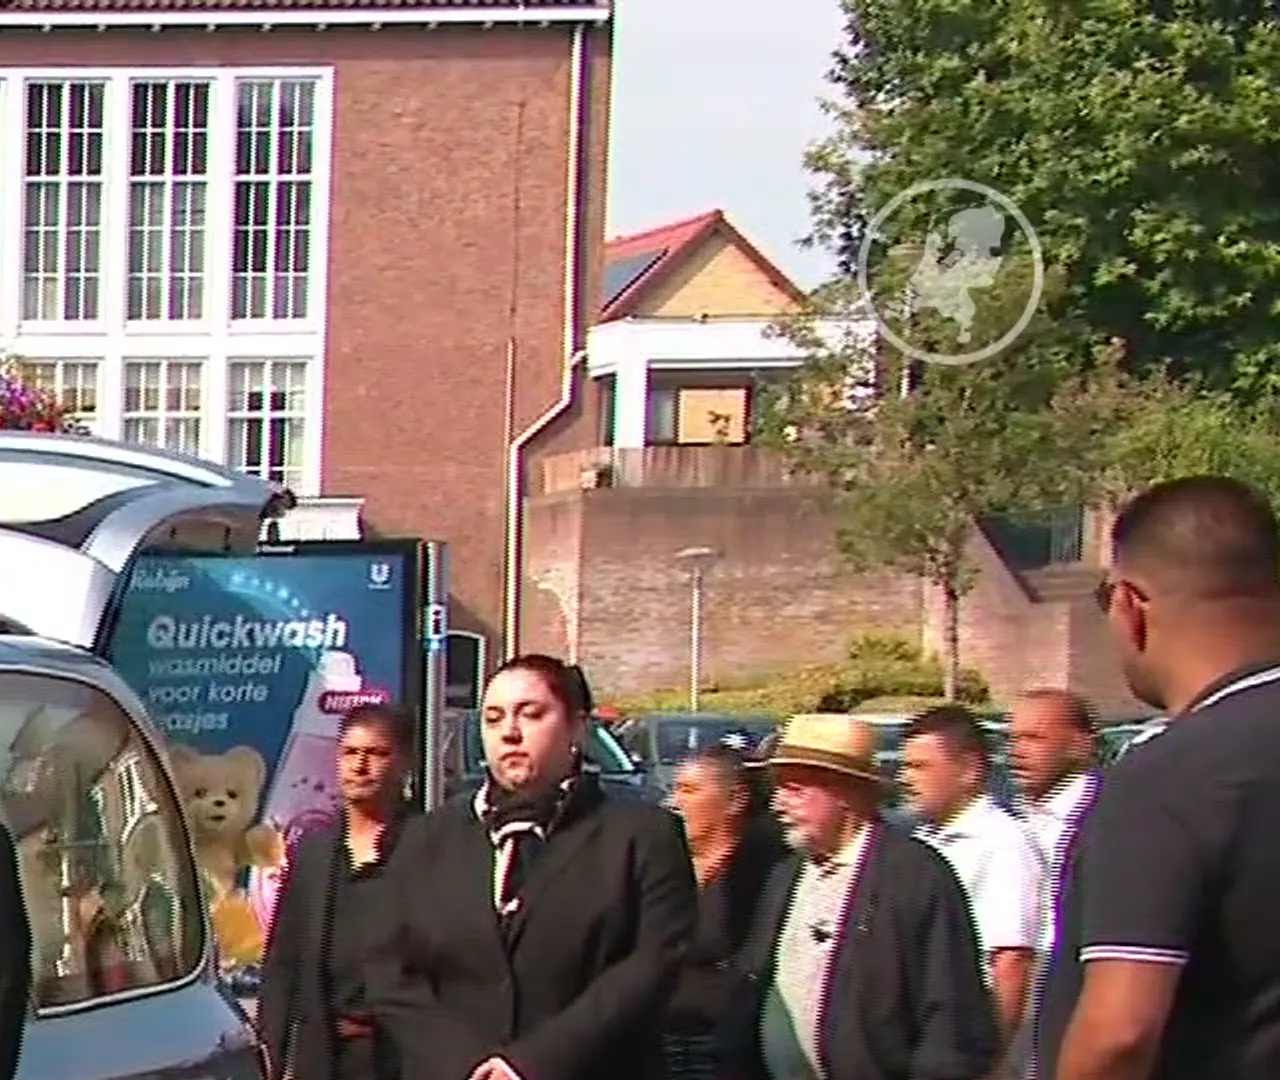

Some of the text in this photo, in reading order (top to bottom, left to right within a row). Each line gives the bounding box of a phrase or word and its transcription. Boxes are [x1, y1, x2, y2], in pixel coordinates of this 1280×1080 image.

[147, 613, 347, 649] Quickwash
[148, 653, 281, 676] wasmiddel
[148, 681, 269, 702] voor korte
